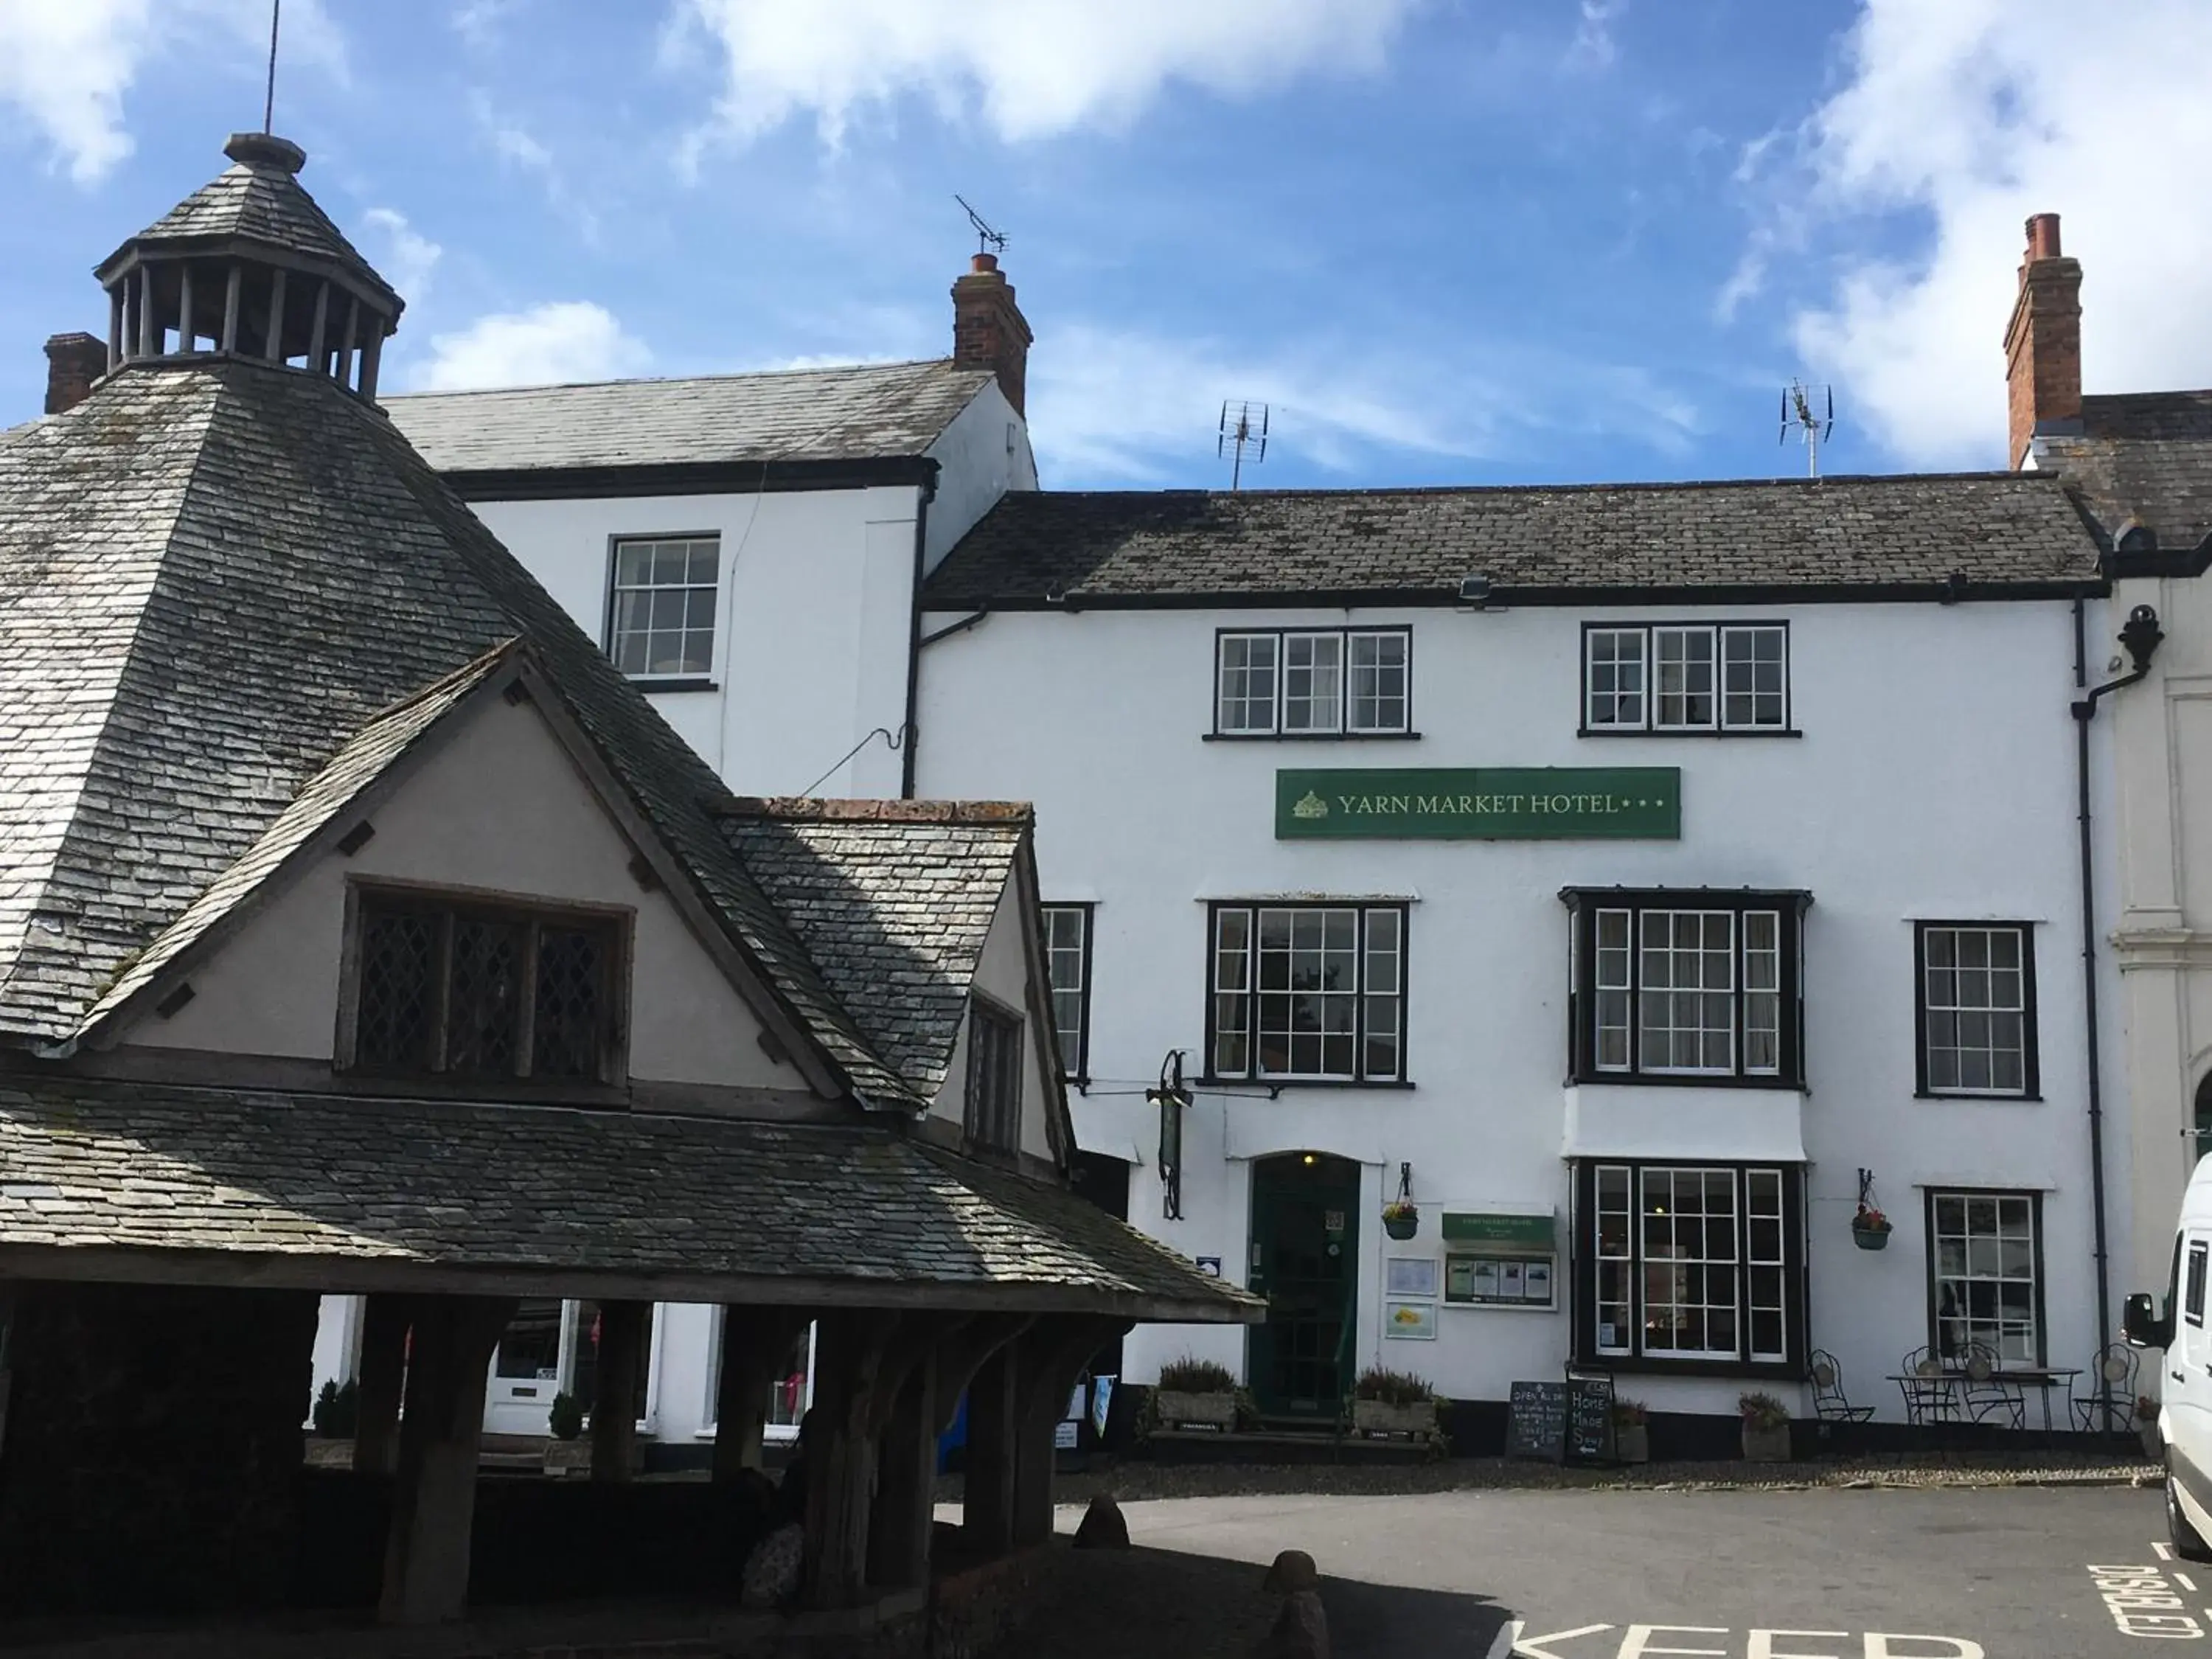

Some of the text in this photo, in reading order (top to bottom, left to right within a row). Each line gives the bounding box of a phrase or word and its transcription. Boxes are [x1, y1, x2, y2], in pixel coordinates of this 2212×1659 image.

[1338, 795, 1618, 813] YARN MARKET HOTEL
[1572, 1391, 1605, 1410] HOME
[1572, 1411, 1603, 1428] MADE
[2086, 1565, 2205, 1638] DISABLED
